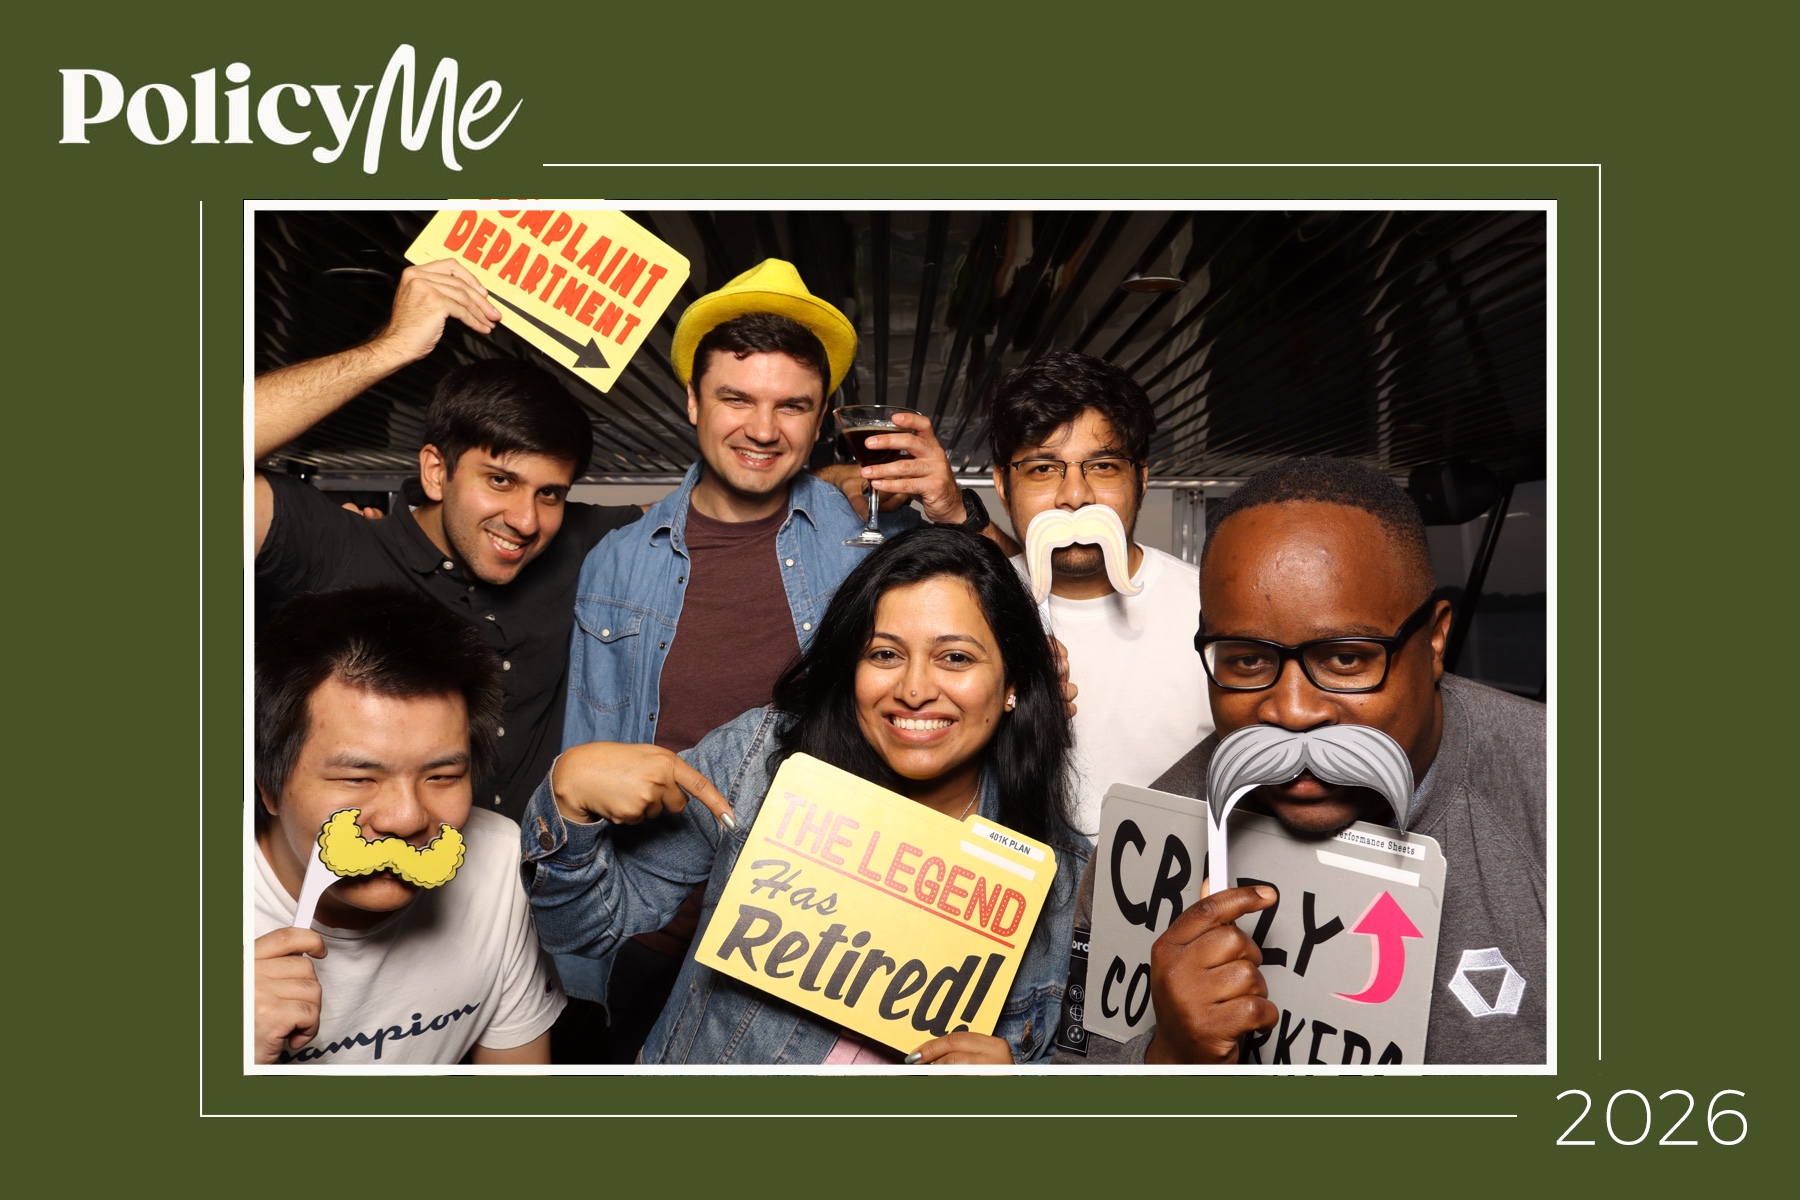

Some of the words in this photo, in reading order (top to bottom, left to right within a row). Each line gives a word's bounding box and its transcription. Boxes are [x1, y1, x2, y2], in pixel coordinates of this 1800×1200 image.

[443, 210, 642, 345] DEPARTMENT
[496, 210, 668, 308] MPLAINT
[750, 858, 838, 915] Has
[775, 791, 861, 866] THE
[857, 831, 1027, 938] LEGEND
[989, 831, 1010, 846] 401K
[1008, 839, 1031, 855] PLAN
[1339, 830, 1385, 849] erformance
[1387, 841, 1416, 856] Sheets
[1110, 819, 1345, 977] CRZY
[716, 903, 1007, 1037] Retired!
[278, 1001, 481, 1065] ampion
